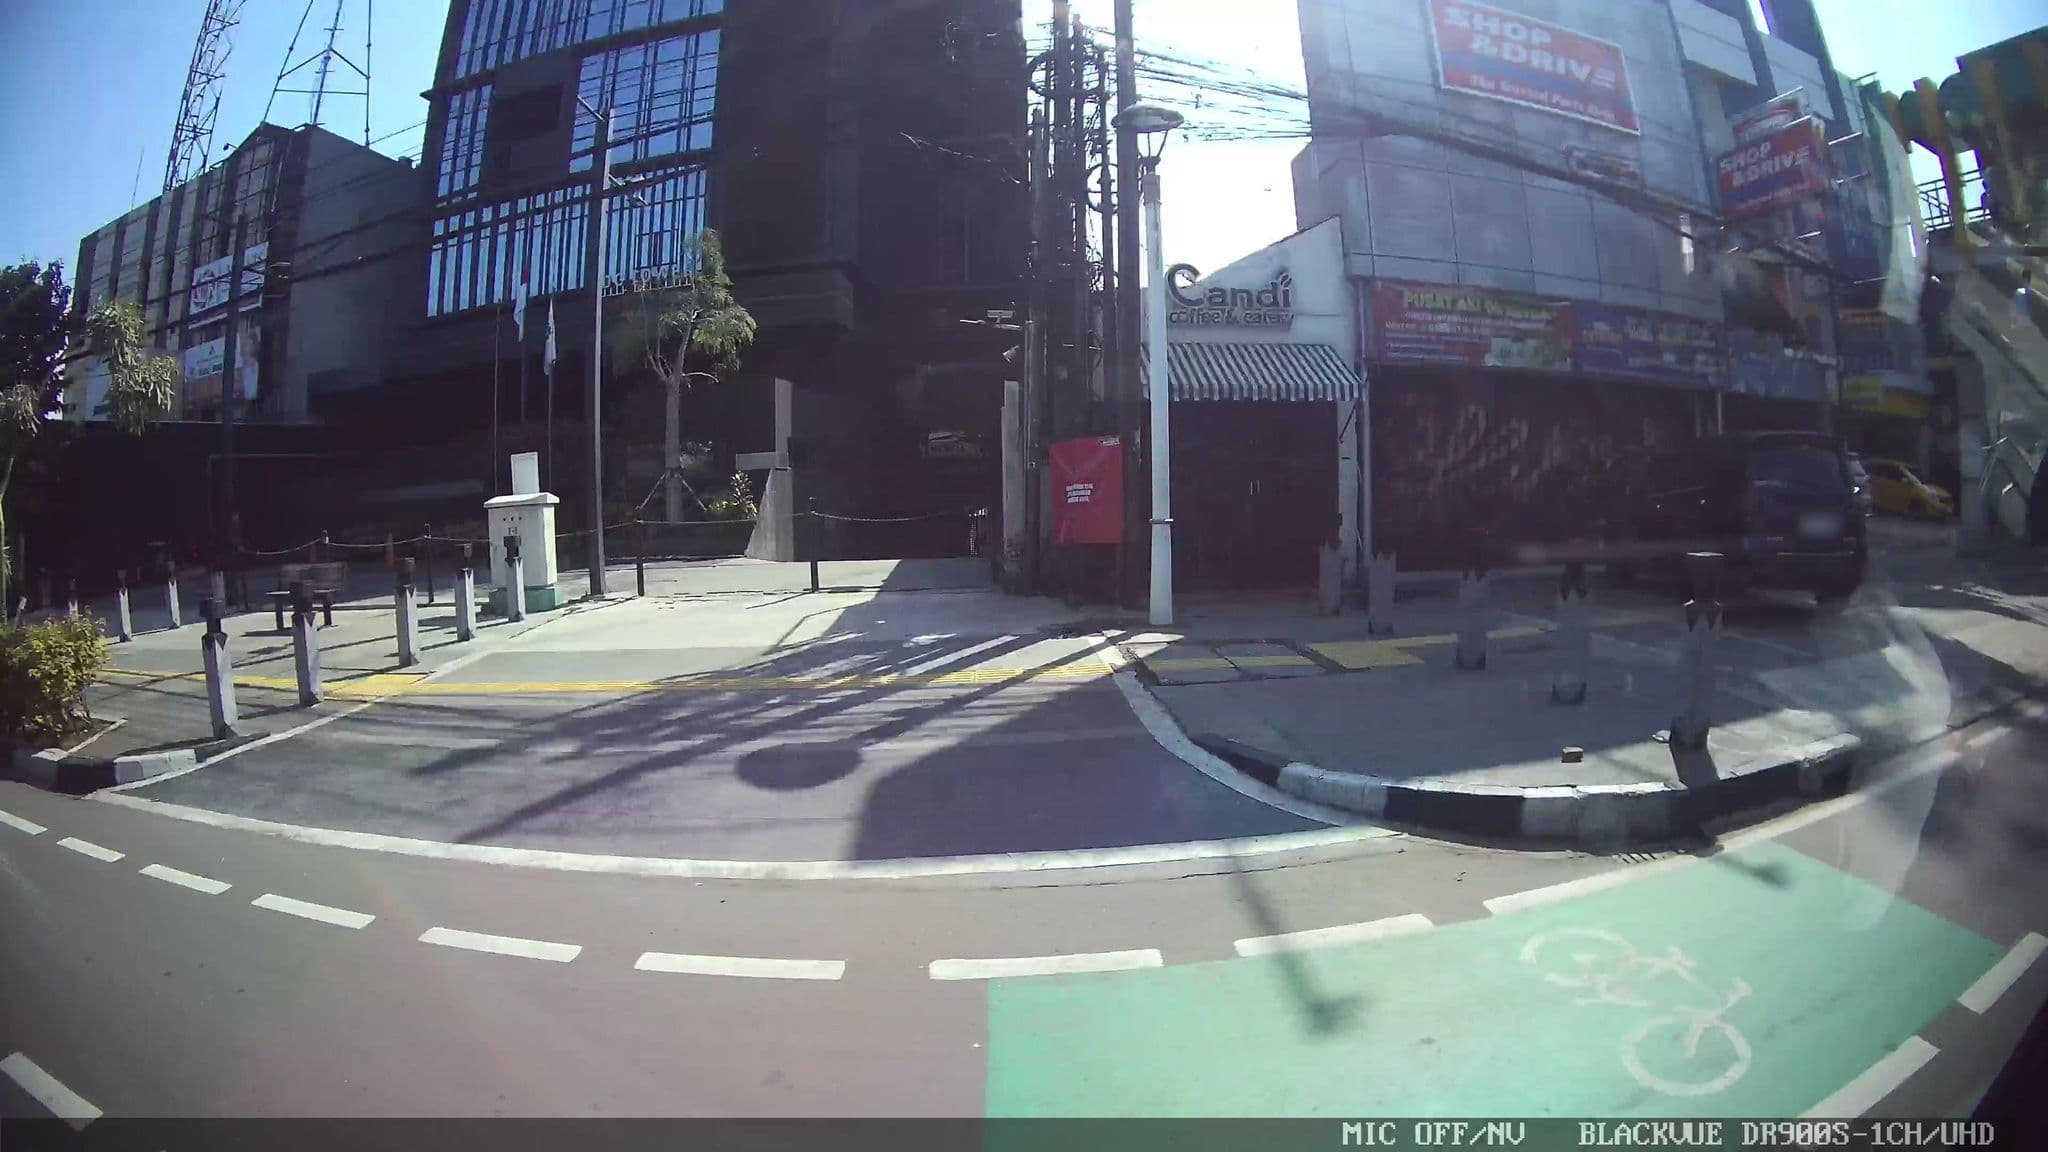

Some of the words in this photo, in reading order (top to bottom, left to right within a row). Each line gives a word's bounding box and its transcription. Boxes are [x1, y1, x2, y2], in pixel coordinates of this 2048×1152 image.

[1441, 6, 1553, 47] SHOP
[1470, 34, 1618, 90] &DRIVE
[1719, 140, 1772, 173] SHOP
[1167, 262, 1294, 308] Candi
[1169, 307, 1221, 325] coffee
[1243, 310, 1296, 332] eatery
